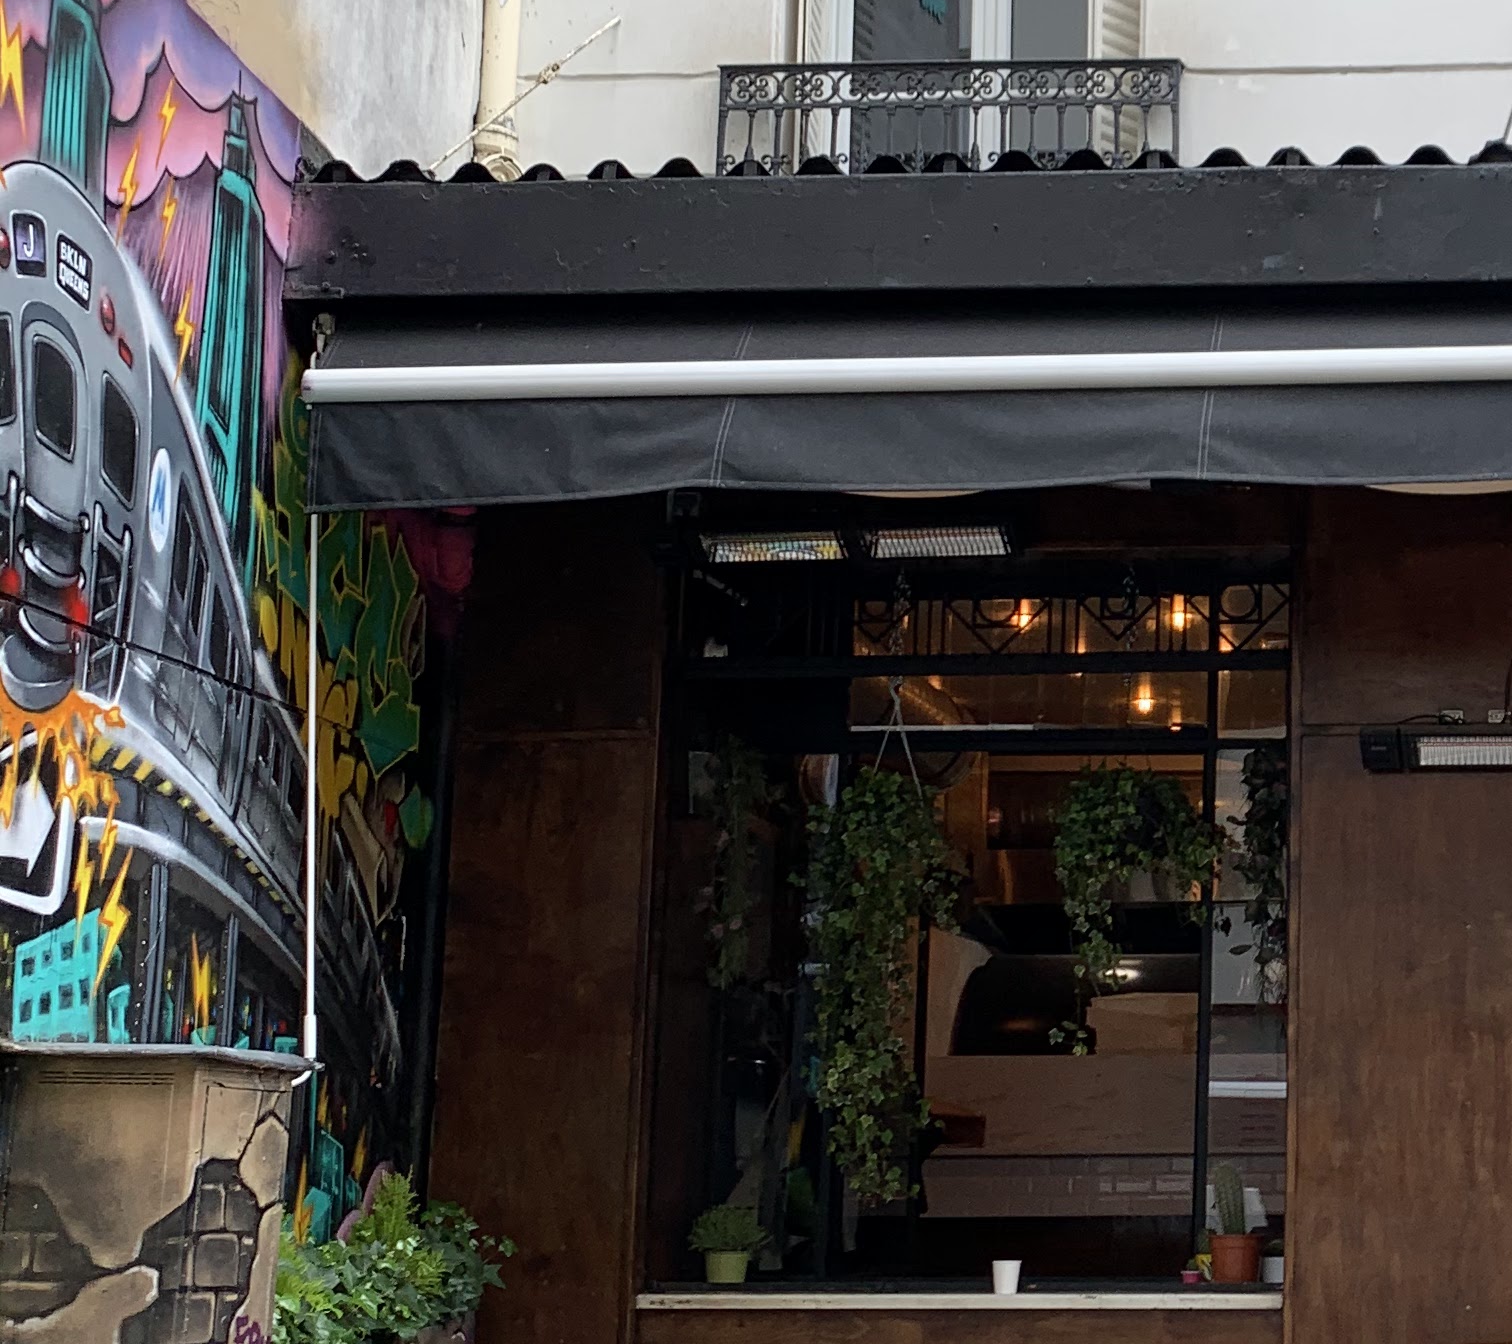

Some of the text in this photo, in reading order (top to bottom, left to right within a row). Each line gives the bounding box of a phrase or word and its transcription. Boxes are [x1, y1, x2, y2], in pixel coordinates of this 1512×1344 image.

[23, 223, 35, 258] J
[60, 241, 87, 277] BKLN
[59, 261, 91, 301] QUEENS
